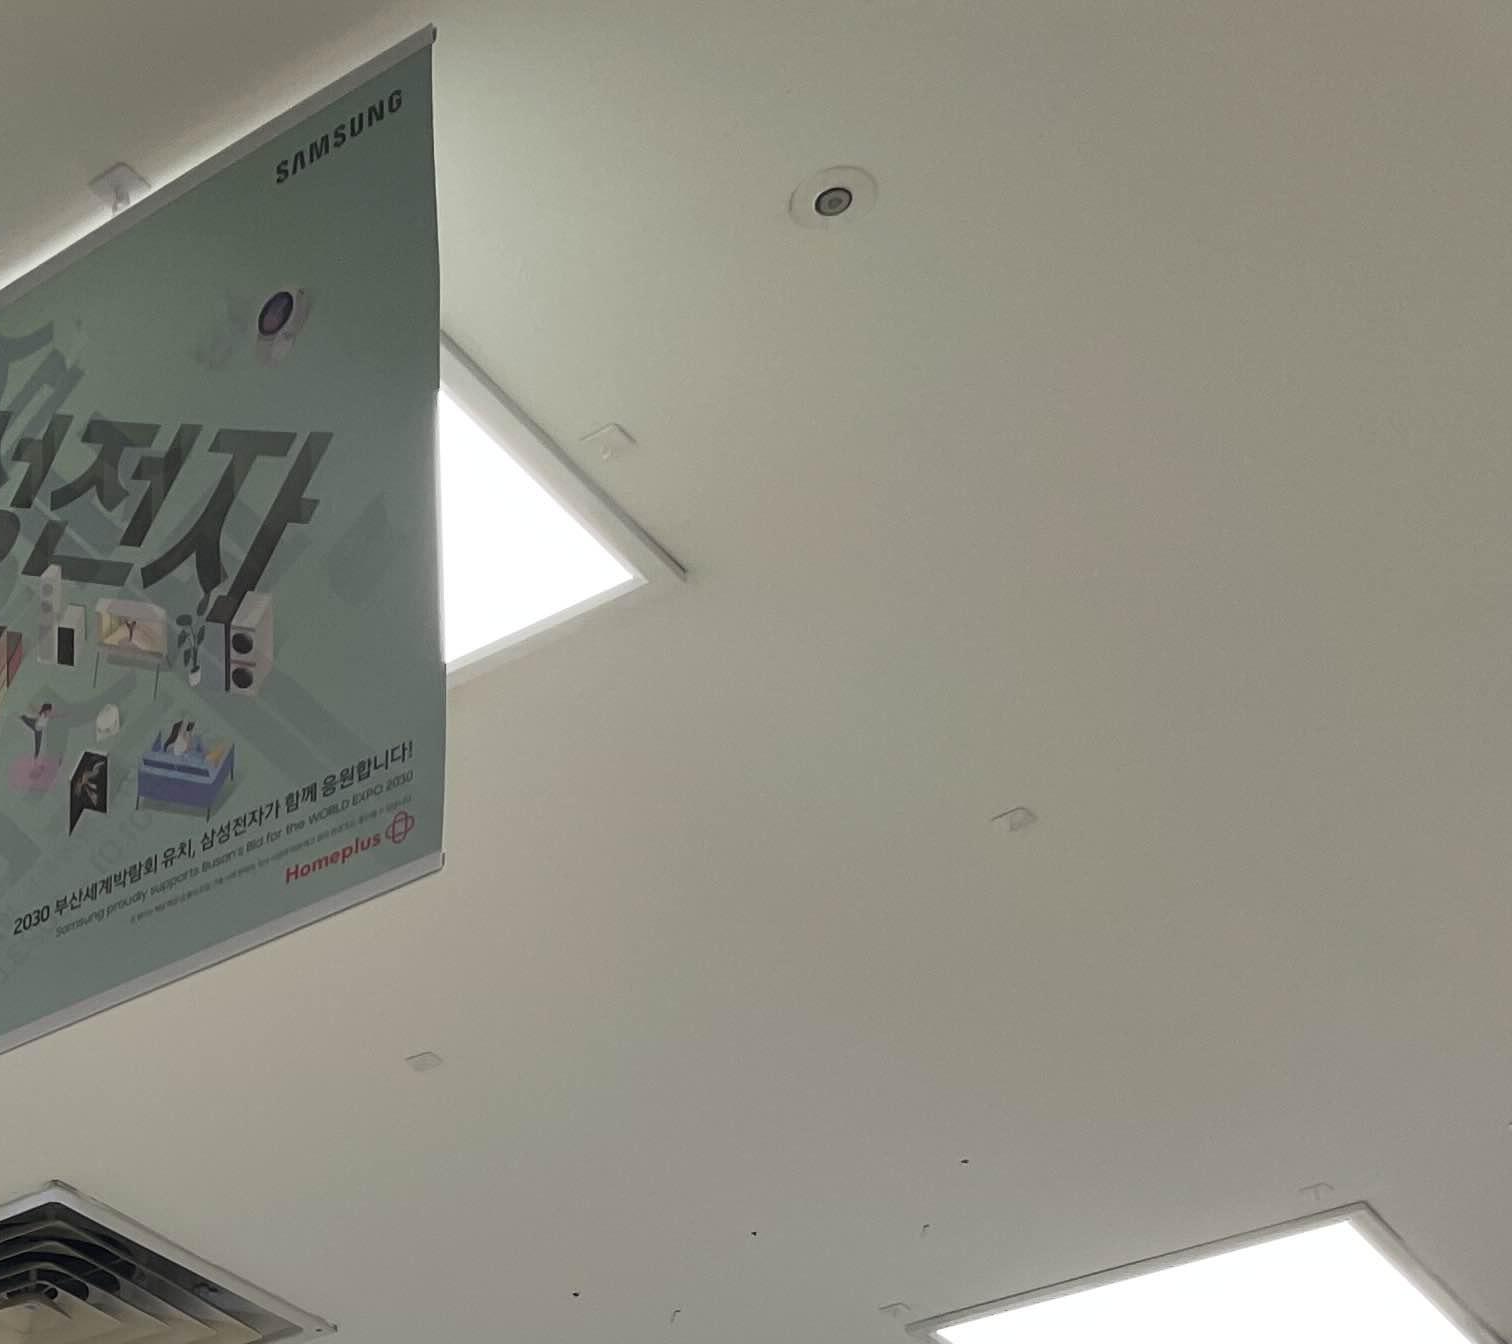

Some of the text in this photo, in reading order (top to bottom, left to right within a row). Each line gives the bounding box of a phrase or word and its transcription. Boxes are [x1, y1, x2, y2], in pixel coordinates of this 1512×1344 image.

[275, 88, 404, 185] SAMSUNG
[13, 905, 50, 935] 2030
[54, 854, 158, 916] 부산세계박람회
[161, 839, 196, 870] 유치,
[200, 800, 280, 852] 삼성전자가
[285, 782, 318, 814] 함께
[322, 740, 414, 797] 응원합니다!
[308, 800, 349, 825] WORLD
[285, 832, 382, 884] Homeplus
